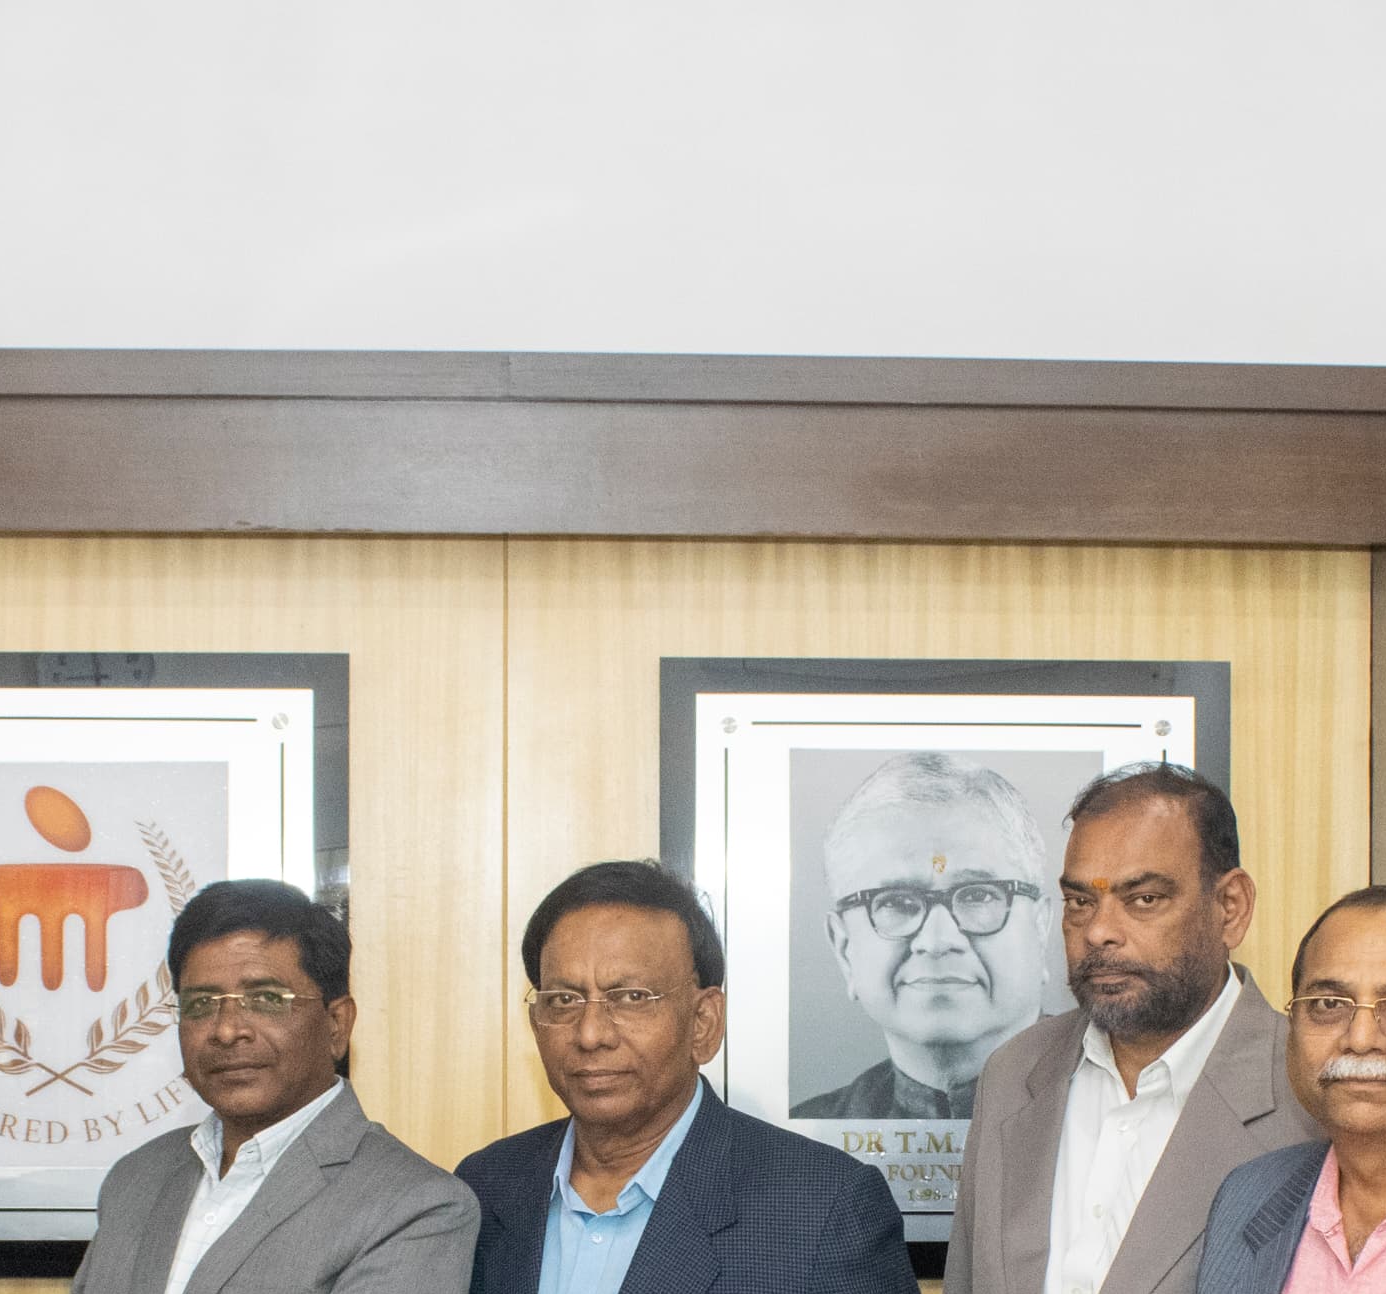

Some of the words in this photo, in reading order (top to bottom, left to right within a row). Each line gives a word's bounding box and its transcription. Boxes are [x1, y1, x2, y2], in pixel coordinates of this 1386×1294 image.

[84, 1110, 124, 1143] BY
[134, 1077, 187, 1125] LIF
[842, 1131, 885, 1154] DR
[887, 1164, 963, 1182] FOUN
